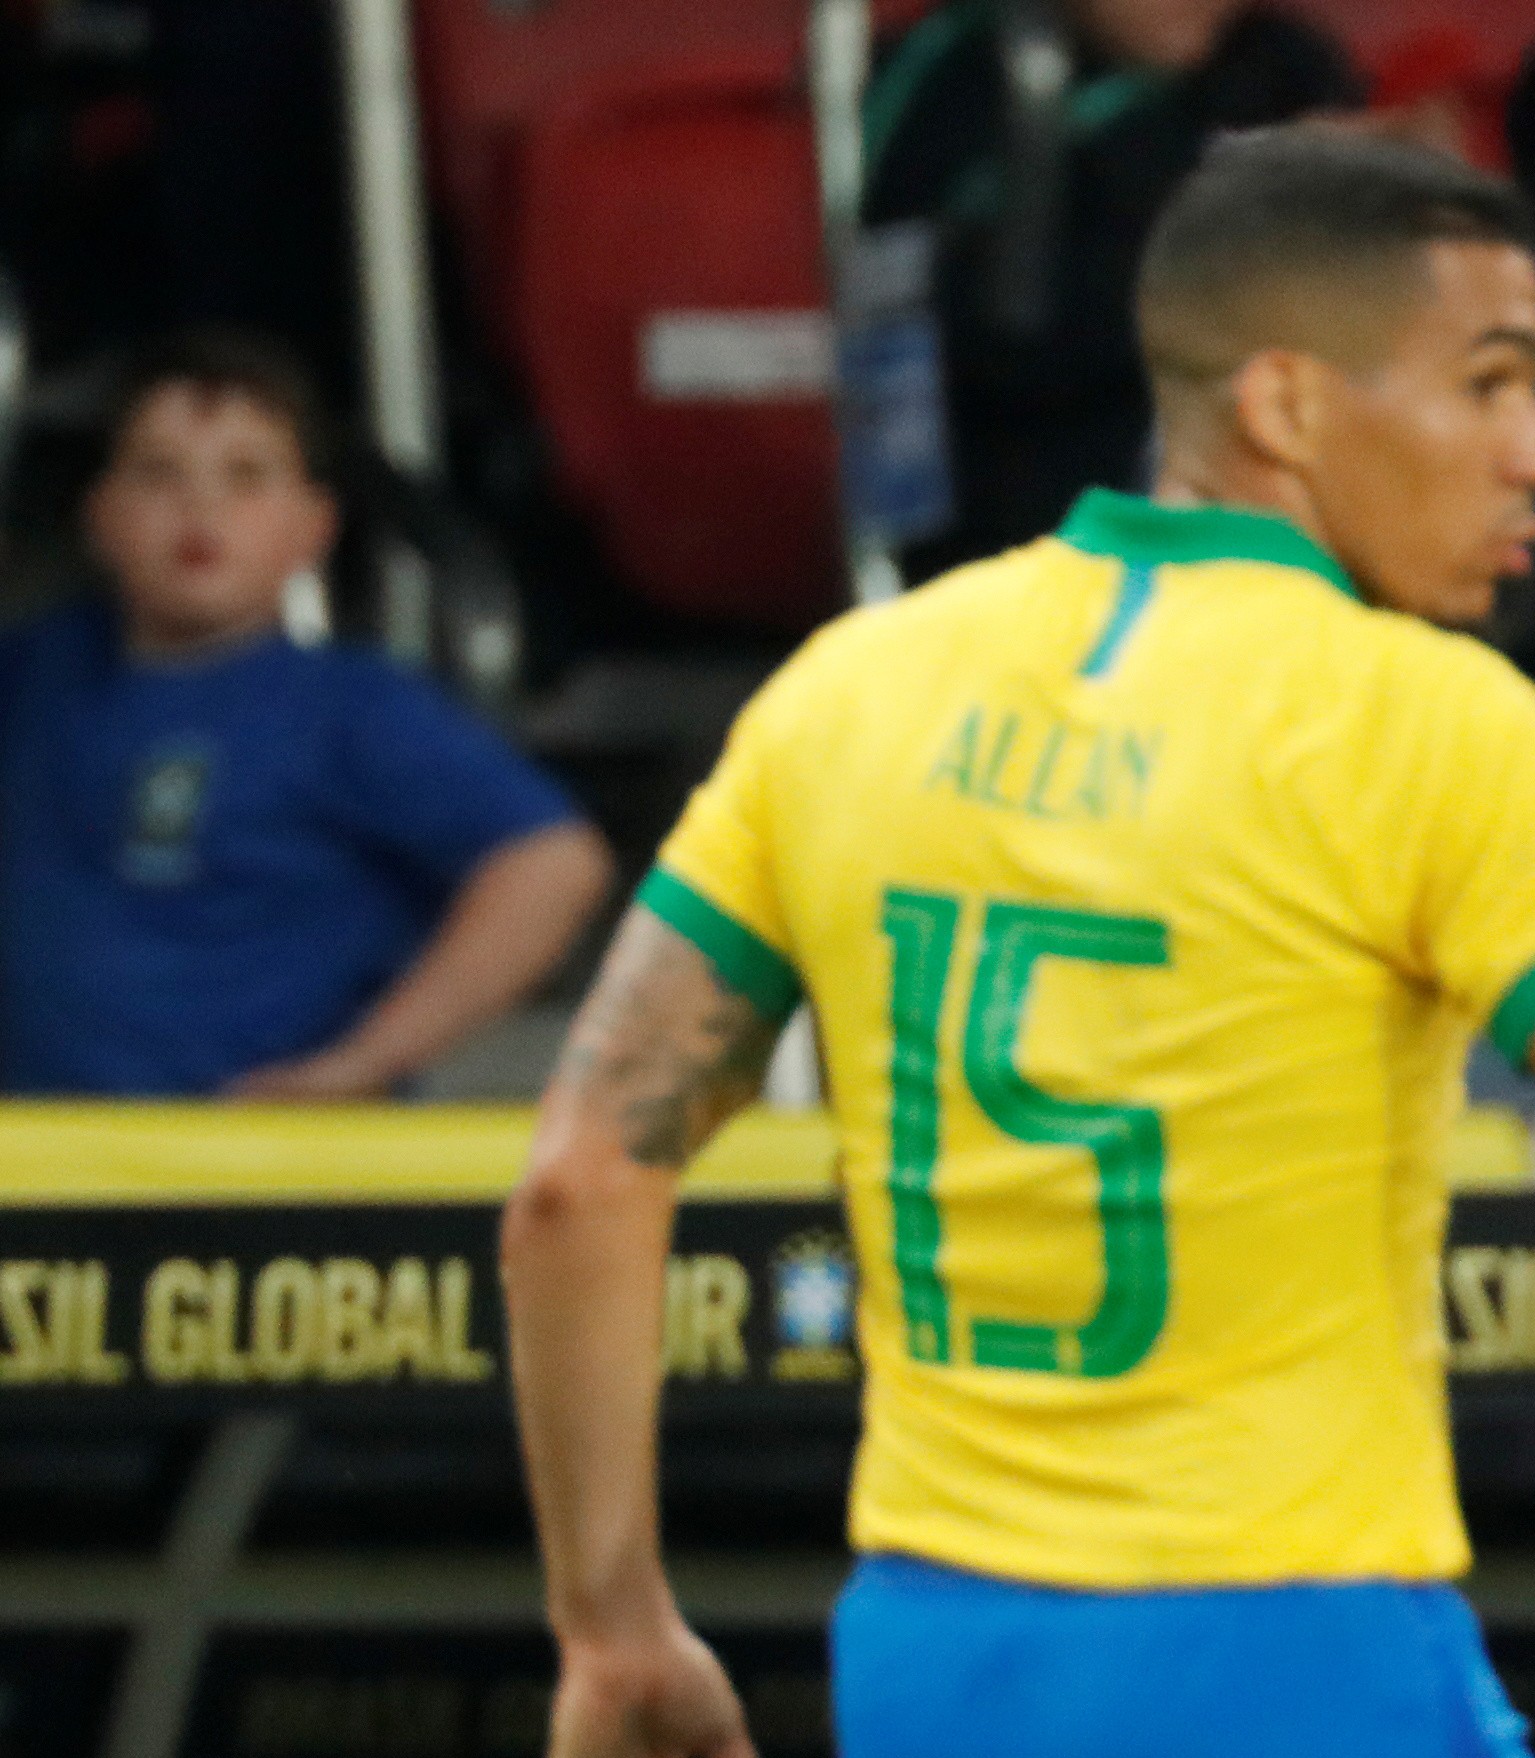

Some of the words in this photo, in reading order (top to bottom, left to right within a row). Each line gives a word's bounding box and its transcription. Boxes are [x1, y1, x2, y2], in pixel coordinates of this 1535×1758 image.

[880, 883, 1172, 1379] 15
[0, 1256, 128, 1383] SIL
[143, 1255, 492, 1384] GLOBAL
